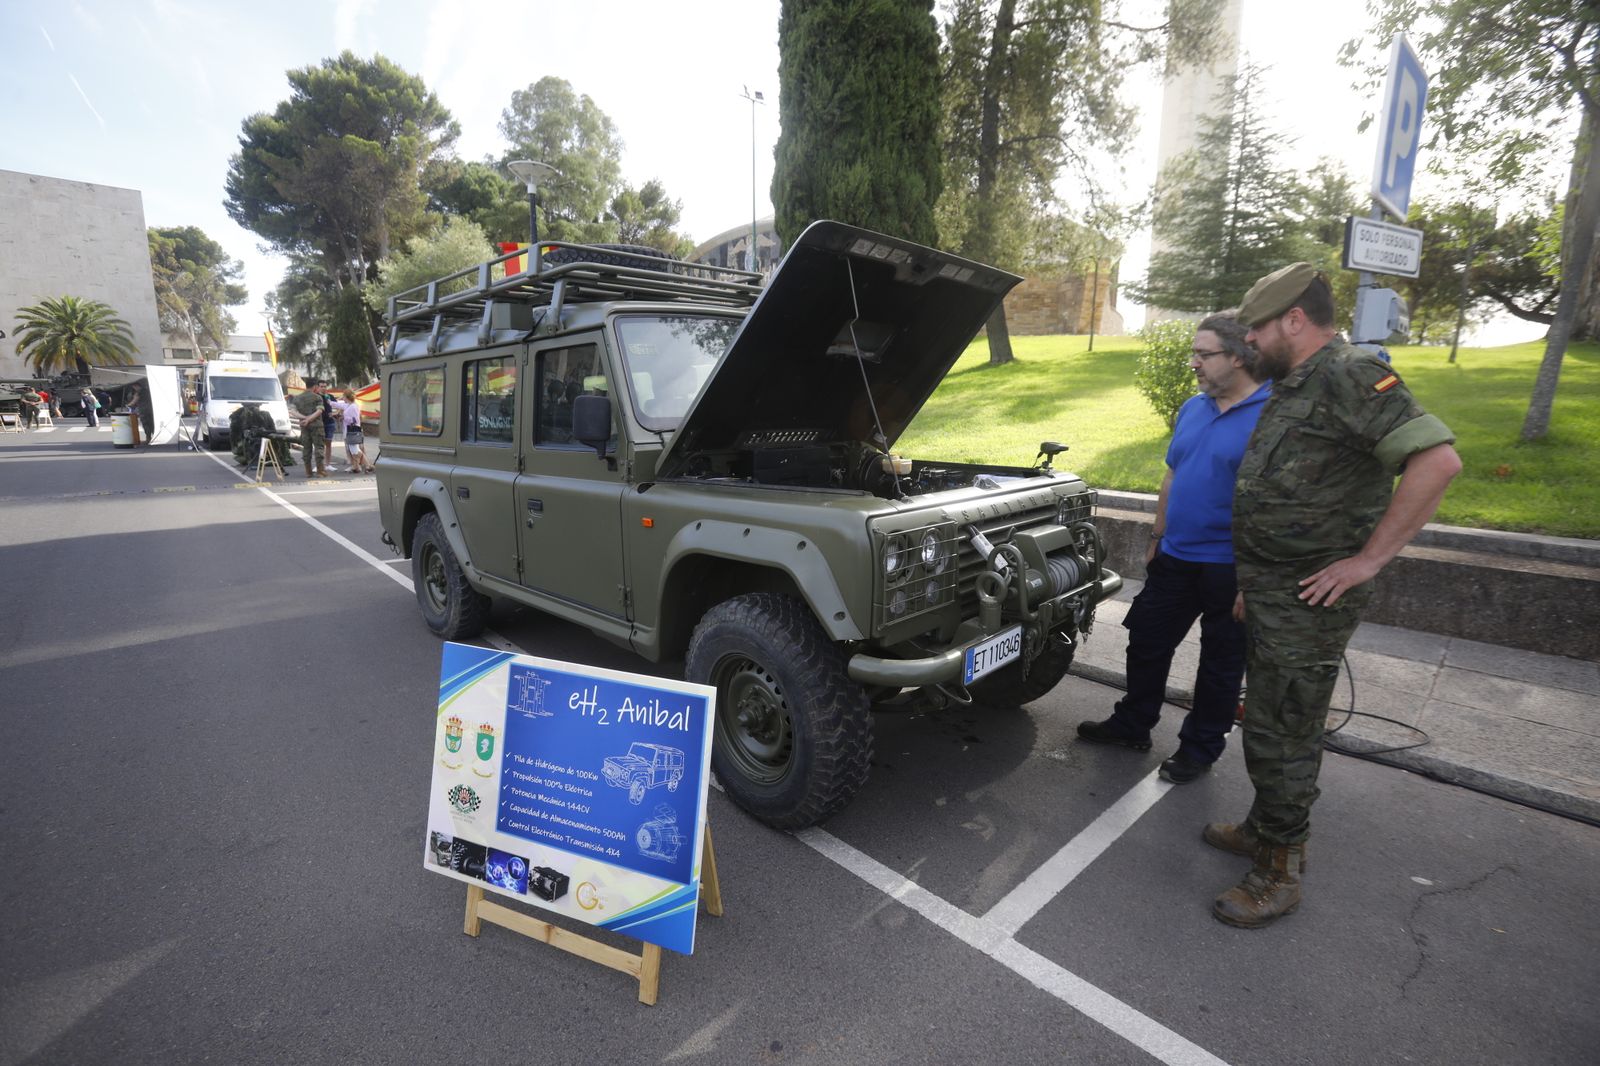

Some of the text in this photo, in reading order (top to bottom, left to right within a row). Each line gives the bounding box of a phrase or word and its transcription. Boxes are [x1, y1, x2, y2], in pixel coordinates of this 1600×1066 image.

[1386, 66, 1418, 188] P
[1360, 229, 1415, 251] SOLO PERSONAL
[1365, 248, 1408, 266] AUTORIZADO
[962, 495, 1049, 520] SANTANA
[973, 648, 986, 673] ET
[990, 632, 1020, 666] 110346
[617, 697, 690, 732] Anibal
[514, 754, 525, 764] Pila
[526, 758, 534, 766] de
[535, 759, 565, 774] Hidrógeno
[566, 766, 574, 776] de
[512, 771, 593, 797] Propulsión 100% Eléctrica
[511, 787, 536, 800] Potencia
[538, 794, 566, 808] Mecánica
[510, 803, 626, 841] Capacidad de Almacenamiento 500Ah
[508, 820, 530, 832] Control
[532, 826, 564, 842] Electrónico
[565, 835, 604, 852] Transmisión
